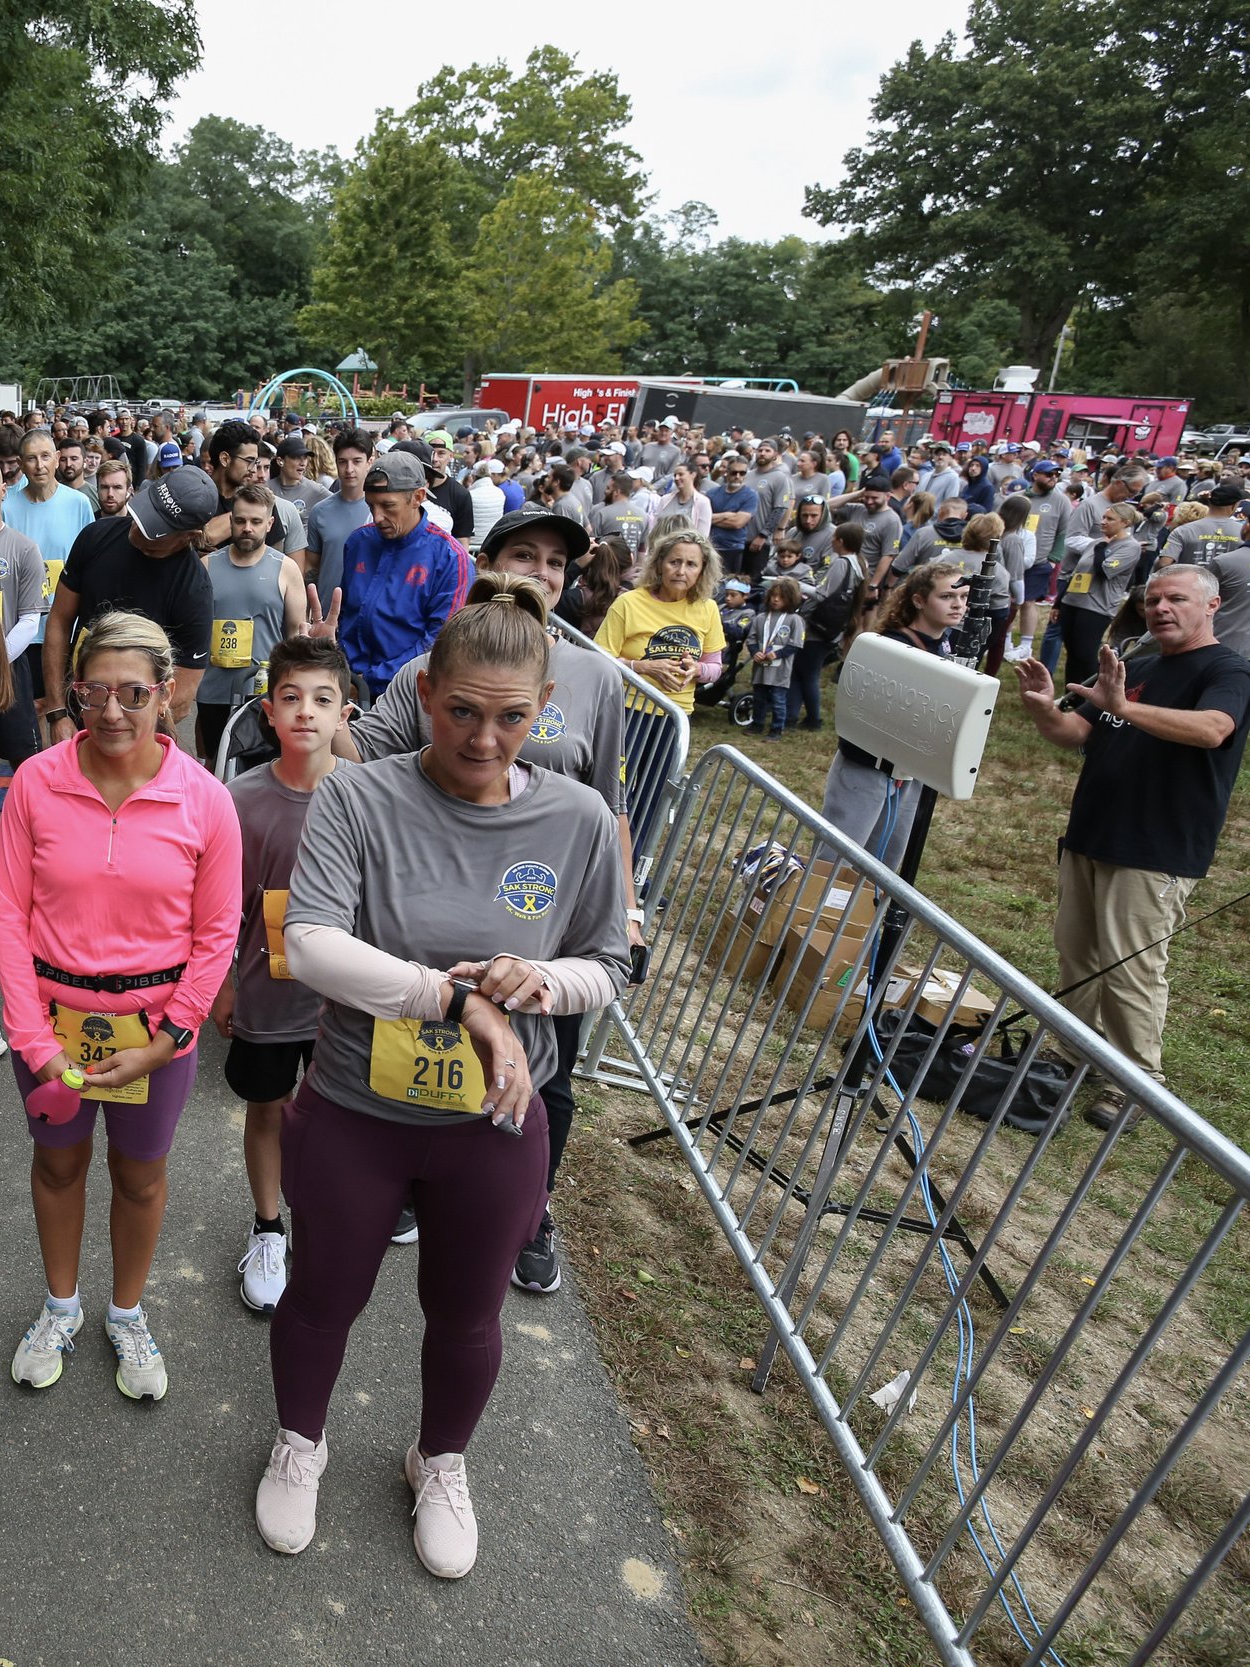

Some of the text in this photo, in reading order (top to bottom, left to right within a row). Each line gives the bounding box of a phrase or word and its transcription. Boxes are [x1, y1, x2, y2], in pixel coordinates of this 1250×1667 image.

[573, 388, 593, 399] High
[605, 388, 612, 397] &
[160, 483, 182, 514] RENOVO
[220, 637, 238, 649] 238
[649, 645, 701, 656] SAK STRONG
[503, 884, 555, 896] SAK STRONG
[36, 962, 99, 989] SPIBEL
[434, 1028, 459, 1037] STRONG
[413, 1056, 464, 1090] 216
[420, 1088, 466, 1102] DUFFY
